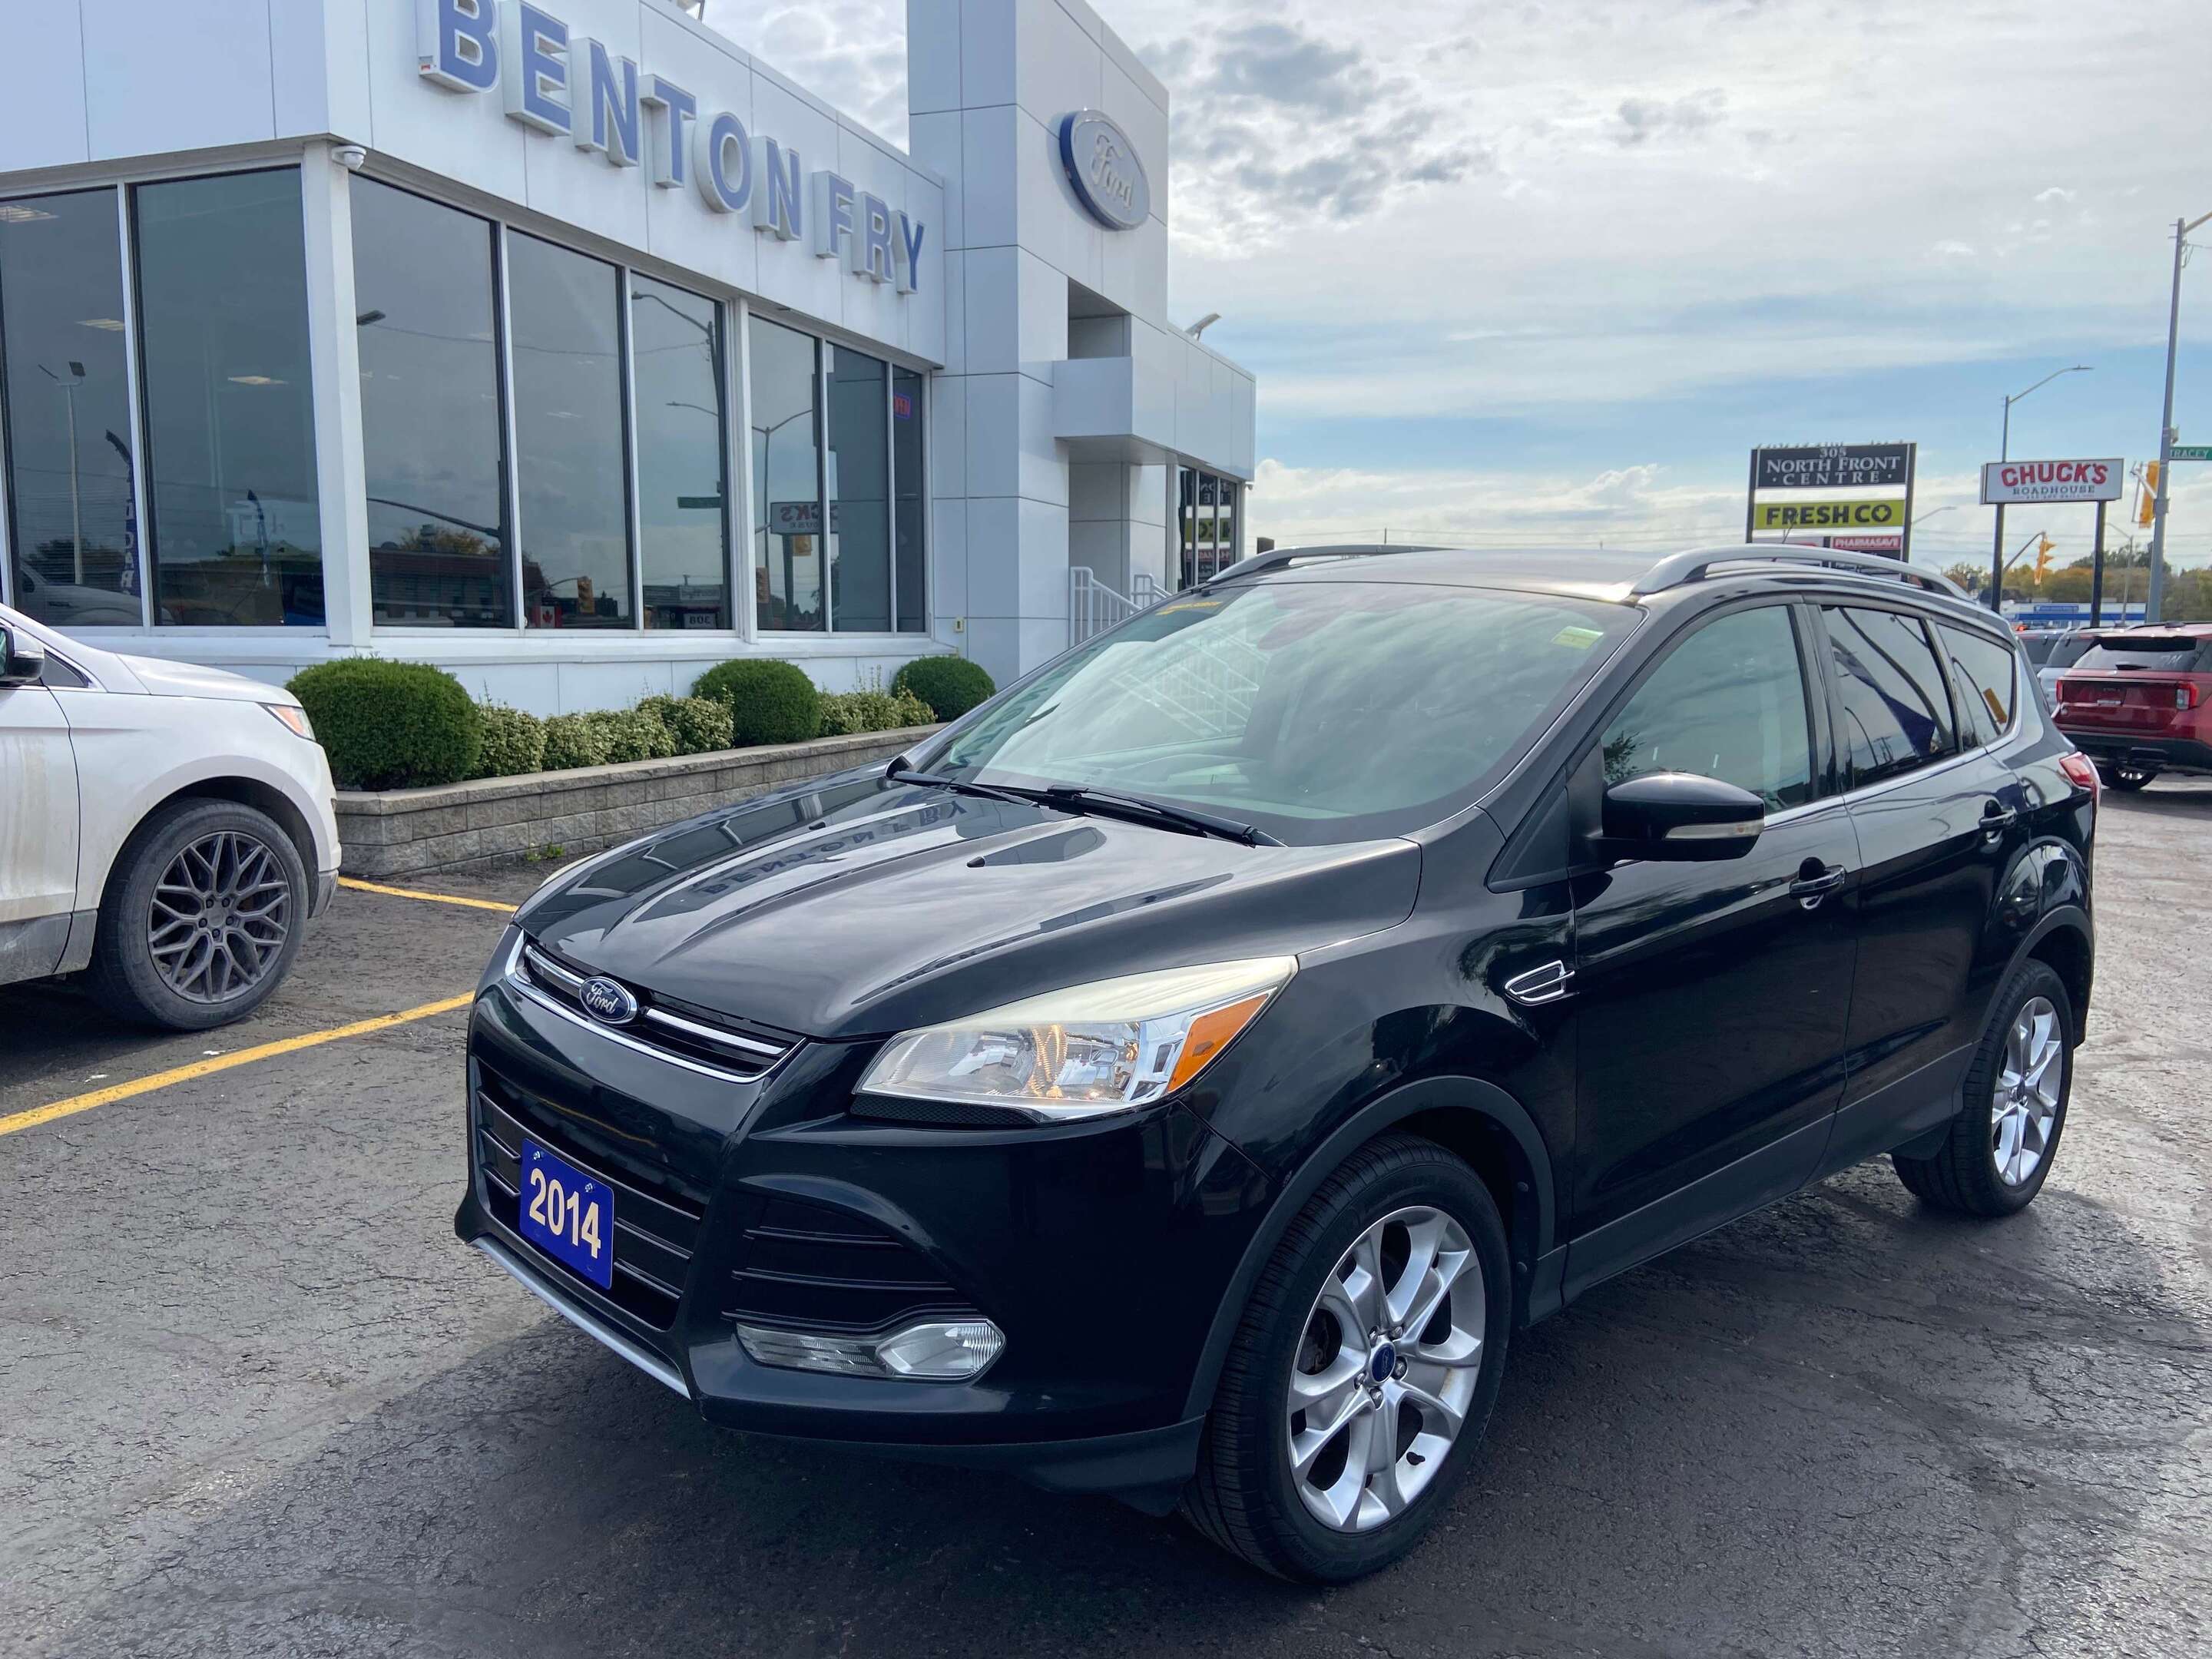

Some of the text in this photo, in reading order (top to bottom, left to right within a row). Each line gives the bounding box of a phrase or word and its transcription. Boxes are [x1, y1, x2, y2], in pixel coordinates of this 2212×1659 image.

[422, 0, 926, 295] BENTON FRY
[1090, 134, 1135, 212] Ford
[1767, 456, 1901, 474] NORTH FRONT
[1783, 471, 1880, 485] CENTRE
[2001, 461, 2108, 487] CHUCK'S
[2013, 485, 2095, 495] ROADHOUSE
[586, 982, 619, 1015] Ford
[528, 1167, 601, 1259] 2014
